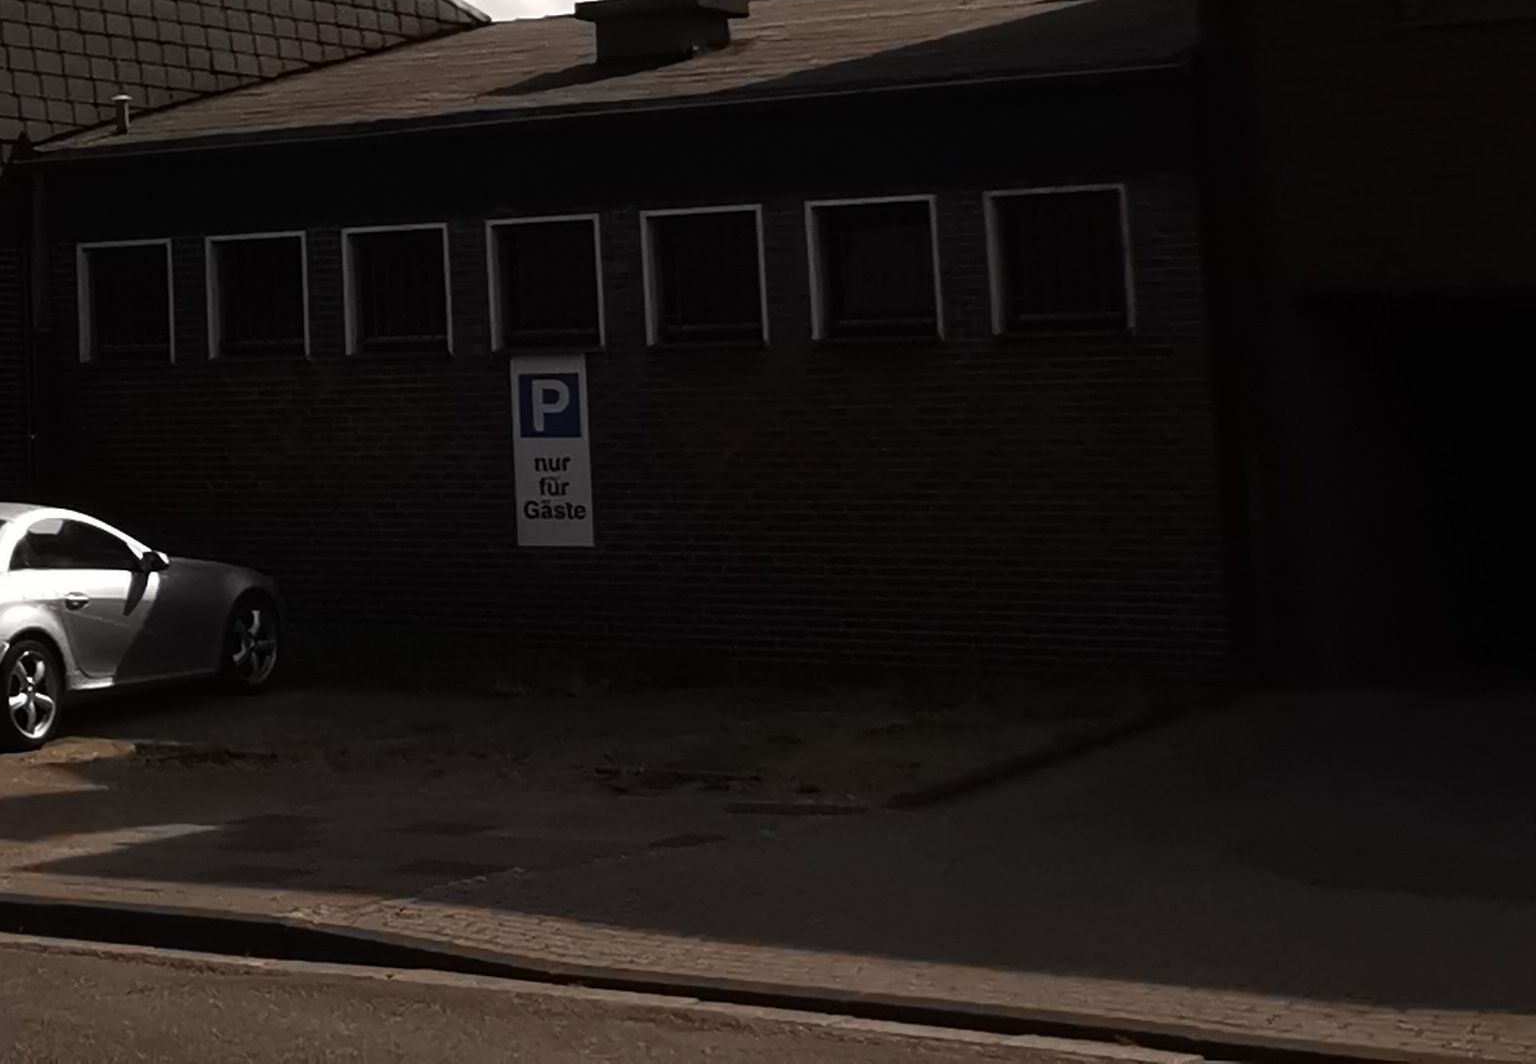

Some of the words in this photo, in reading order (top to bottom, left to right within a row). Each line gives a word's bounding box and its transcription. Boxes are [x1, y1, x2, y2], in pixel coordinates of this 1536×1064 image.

[531, 378, 571, 433] P
[534, 456, 571, 472] nur
[539, 476, 570, 496] für
[524, 500, 586, 520] Gäste
